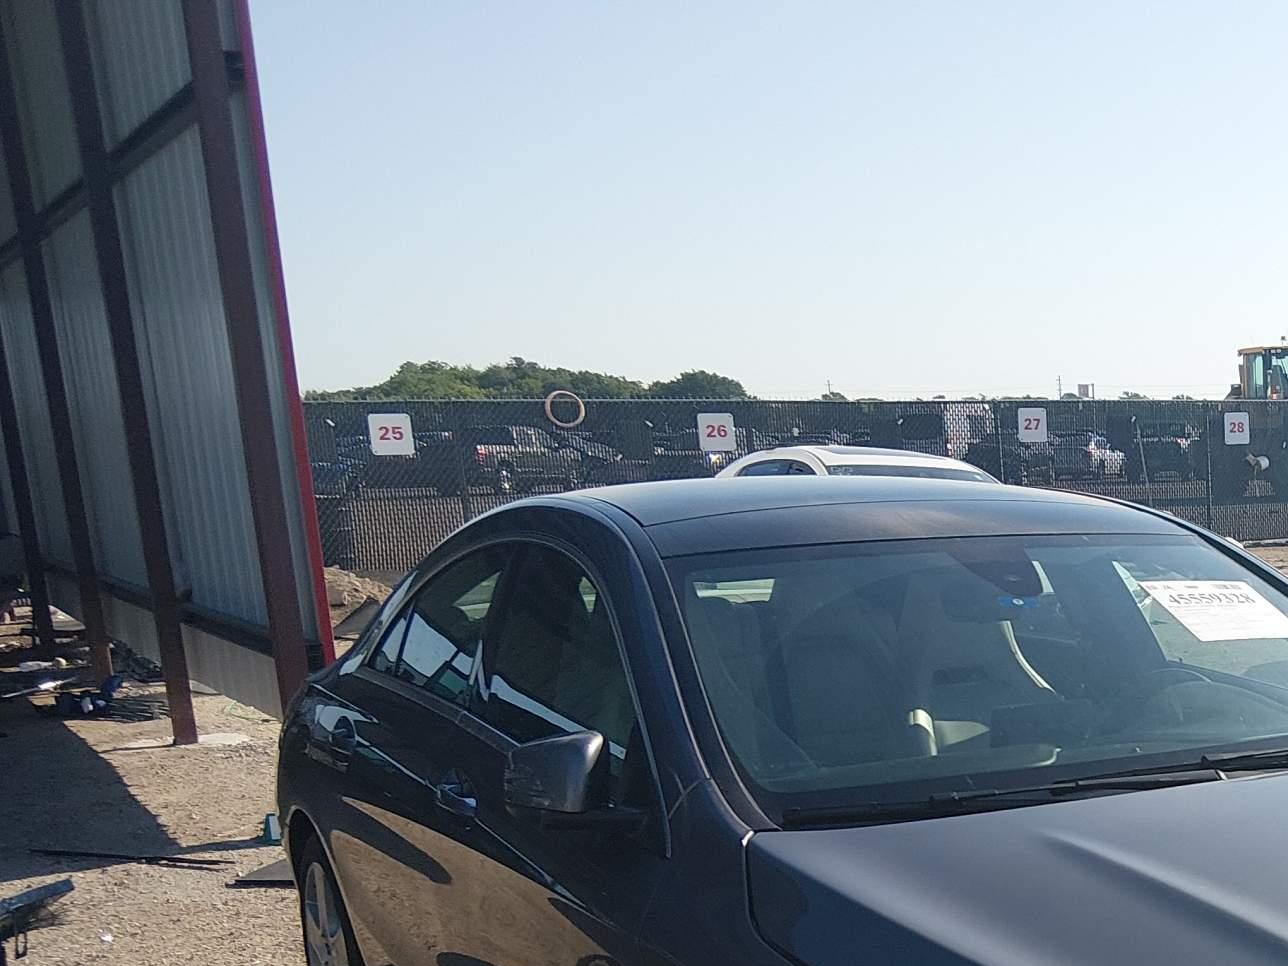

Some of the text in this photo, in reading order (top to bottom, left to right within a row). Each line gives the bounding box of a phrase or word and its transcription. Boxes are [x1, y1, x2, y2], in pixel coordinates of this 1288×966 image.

[706, 424, 728, 438] 26
[1023, 418, 1041, 431] 27
[1229, 421, 1245, 434] 28
[378, 426, 404, 441] 25
[1168, 592, 1256, 605] 45559328
